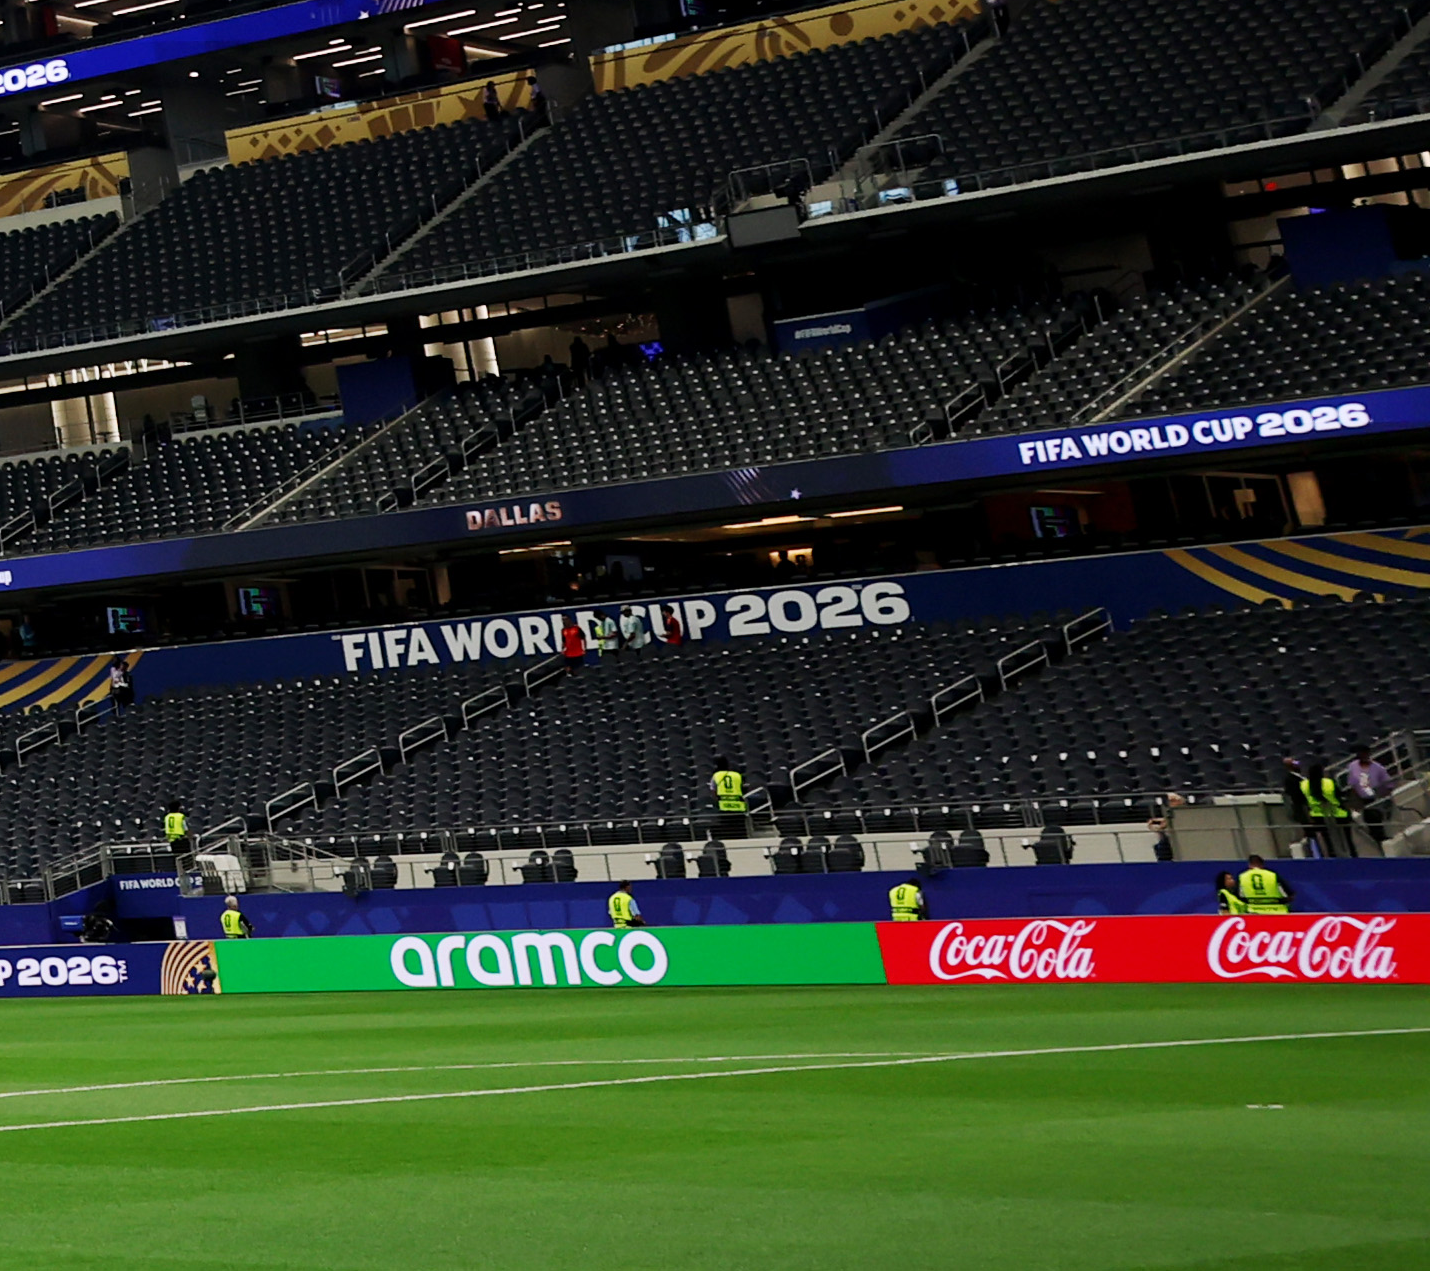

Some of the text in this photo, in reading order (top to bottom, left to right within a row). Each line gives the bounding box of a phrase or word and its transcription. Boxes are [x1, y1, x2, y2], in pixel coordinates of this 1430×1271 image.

[1019, 403, 1372, 464] FIFA WORLD CUP 2026
[466, 500, 561, 530] DALLAS
[337, 627, 439, 671] FIFA
[725, 582, 909, 637] 2026
[120, 880, 140, 890] FIFA
[140, 878, 174, 888] WORLD
[17, 956, 118, 985] 2026
[391, 931, 667, 987] aramco
[929, 920, 1096, 980] Coca-Cola
[1208, 916, 1397, 979] Coca-Cola
